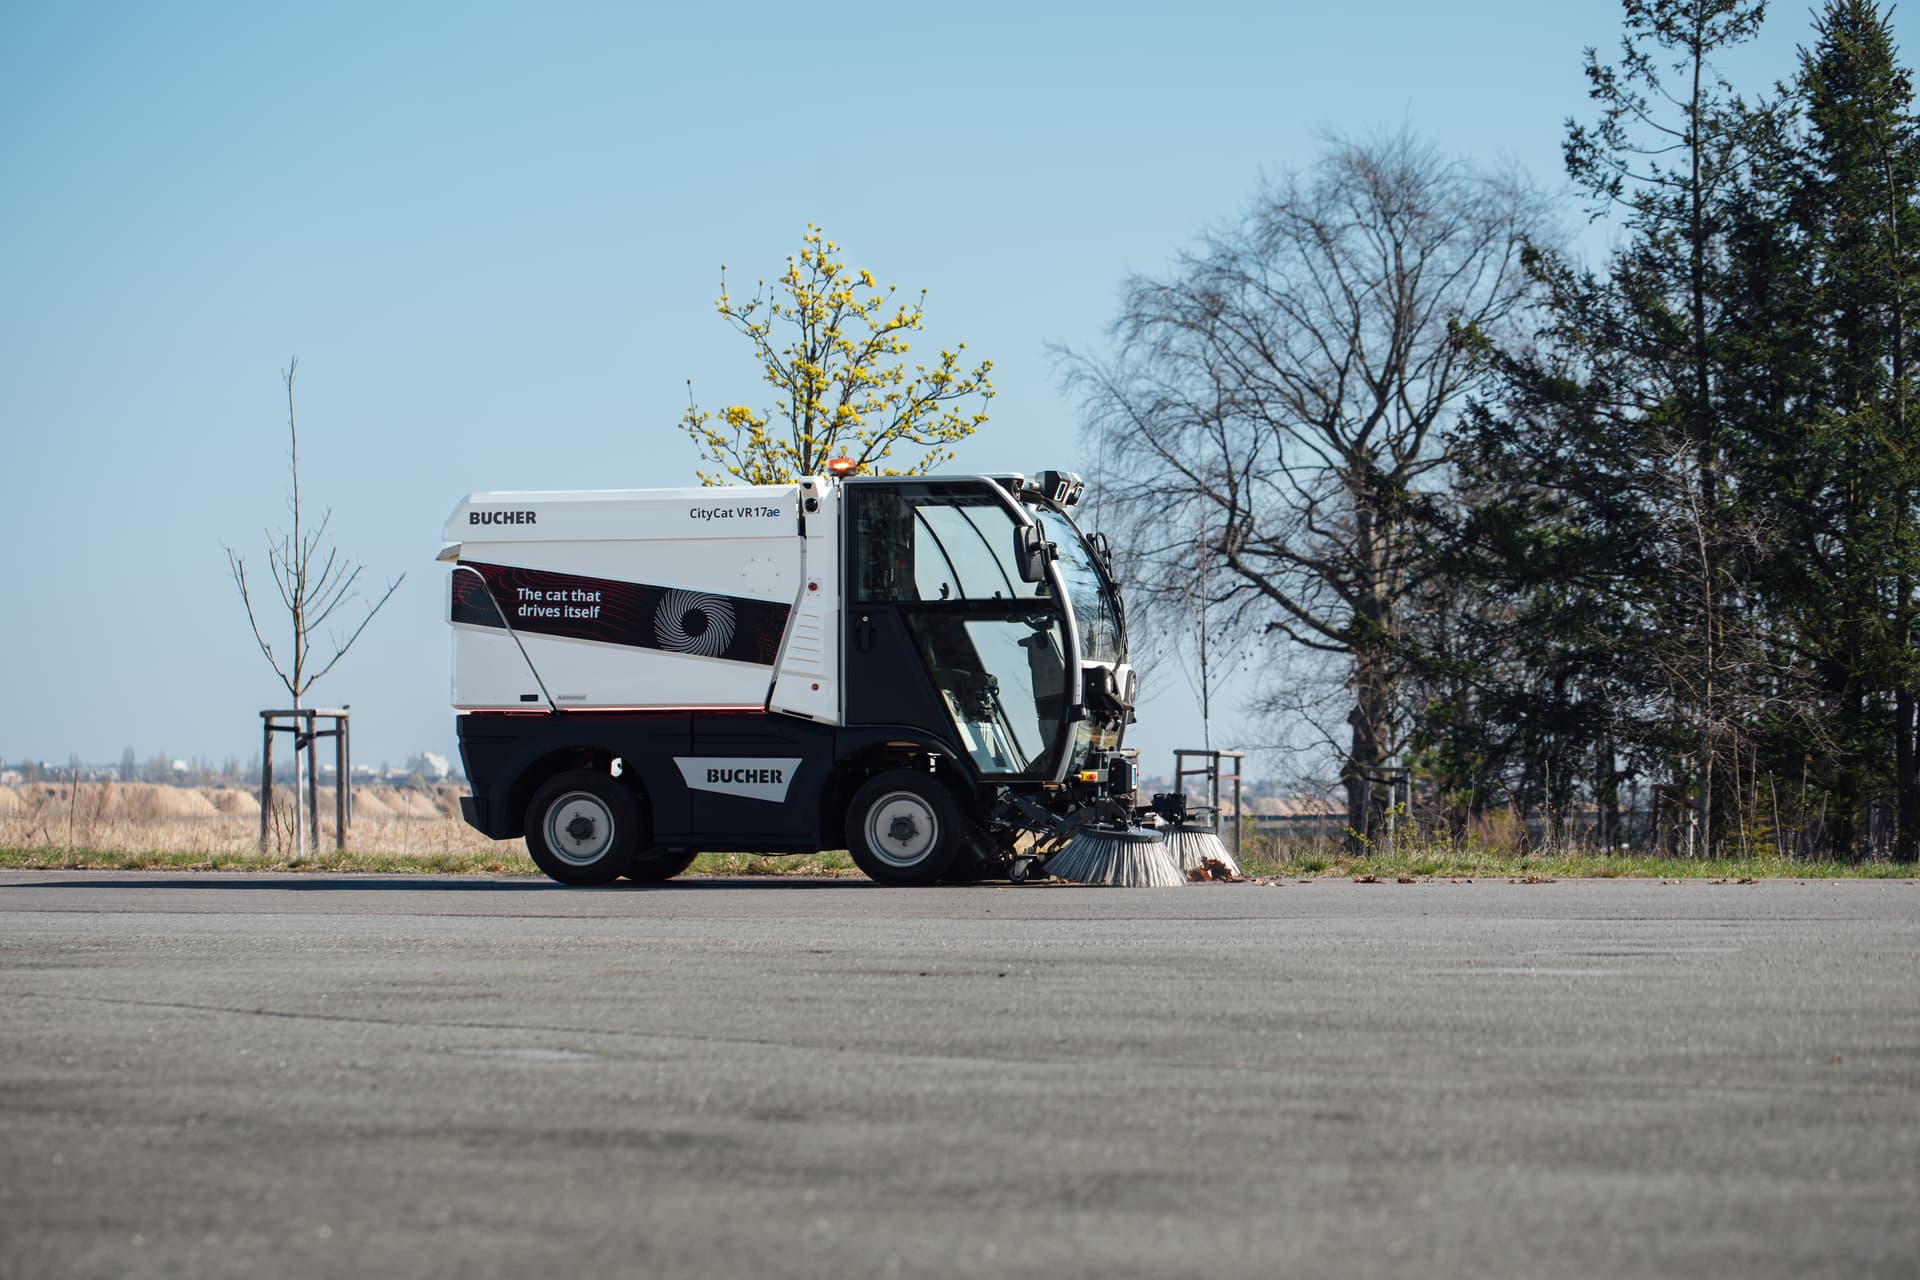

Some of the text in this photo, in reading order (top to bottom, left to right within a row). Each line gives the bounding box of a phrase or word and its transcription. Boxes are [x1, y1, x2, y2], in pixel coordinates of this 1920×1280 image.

[469, 511, 537, 525] BUCHER
[690, 503, 734, 521] CityCat
[516, 587, 601, 602] The cat that
[518, 603, 601, 618] drives itself
[706, 768, 783, 784] BUCHER
